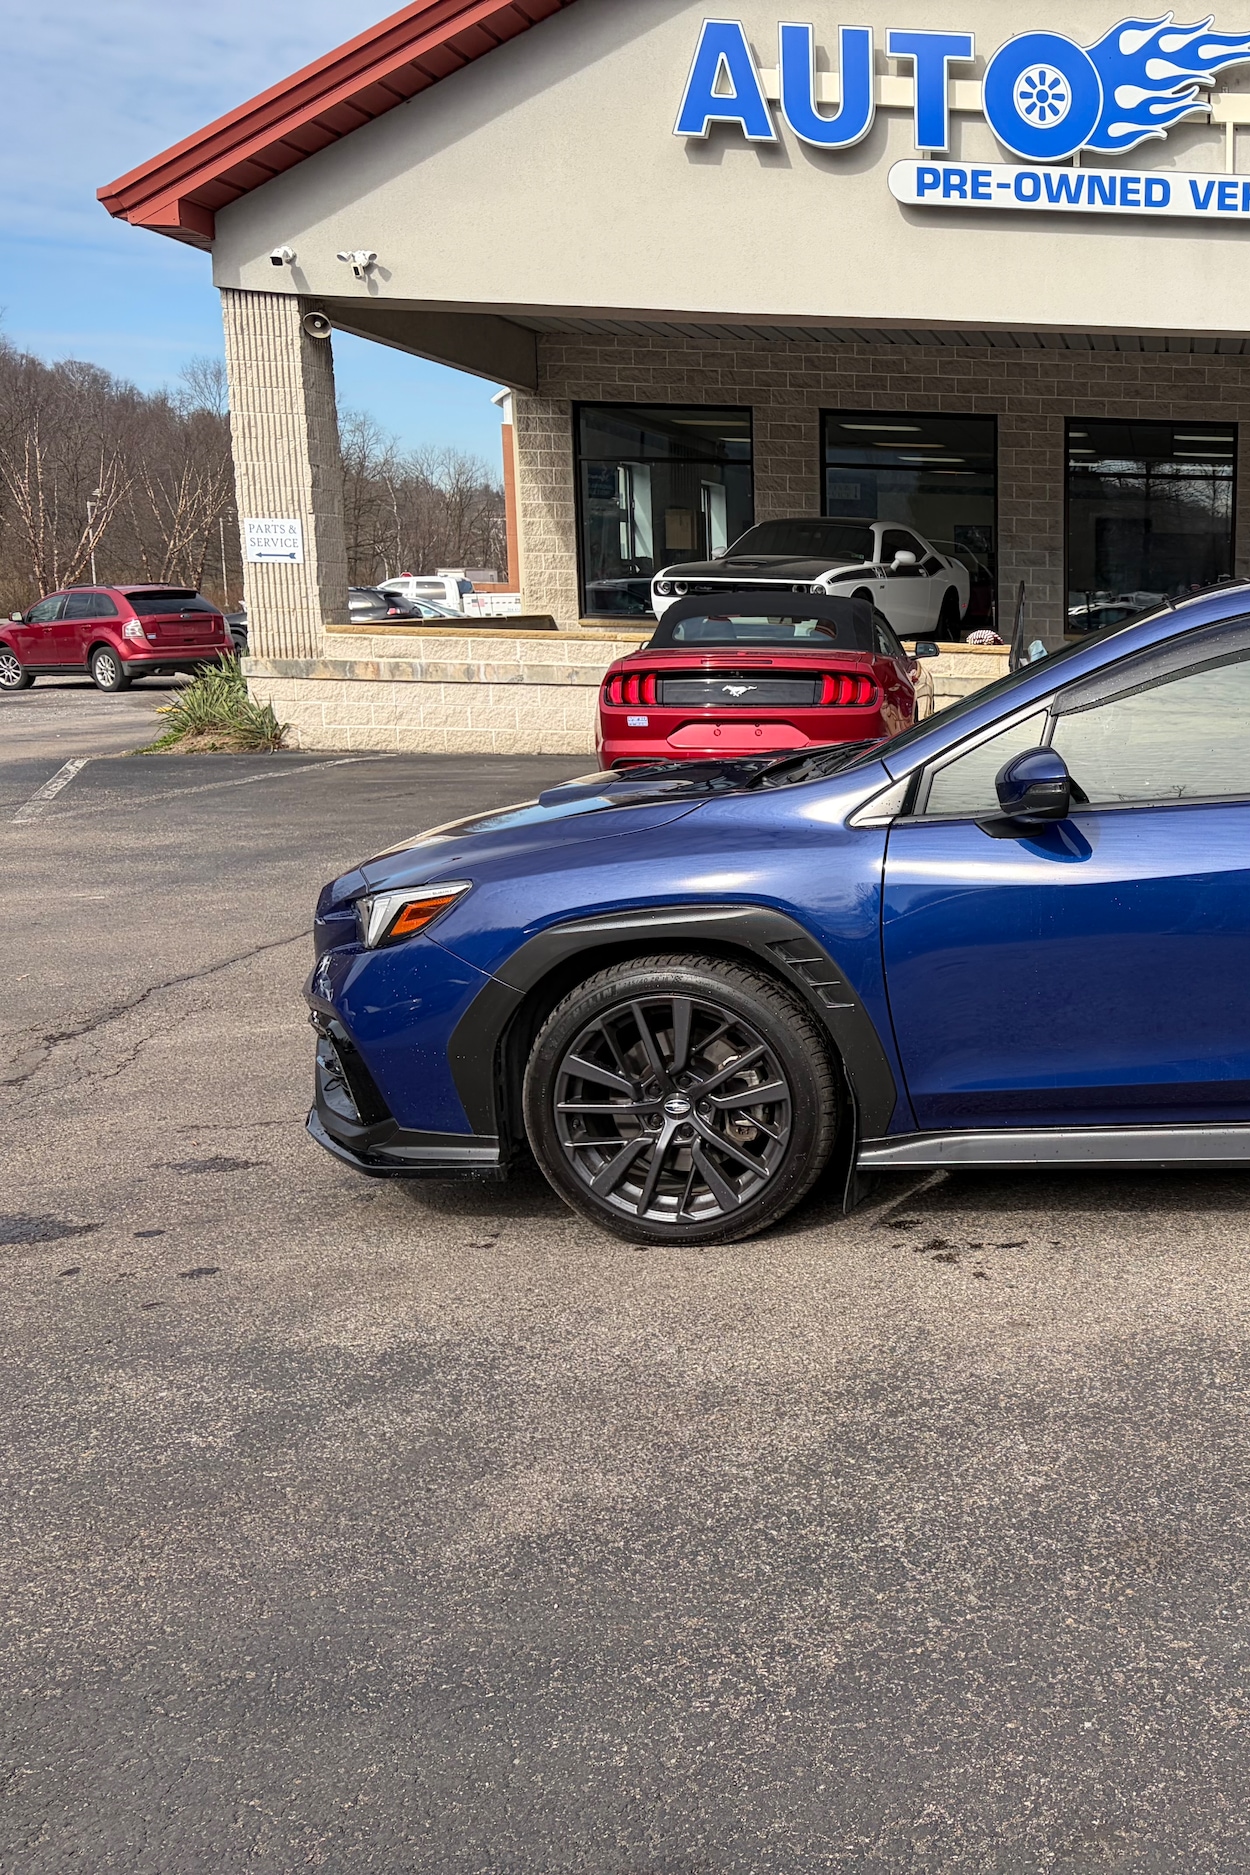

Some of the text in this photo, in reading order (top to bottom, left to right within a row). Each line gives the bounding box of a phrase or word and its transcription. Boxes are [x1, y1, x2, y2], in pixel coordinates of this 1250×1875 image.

[674, 19, 1103, 161] AUTO
[916, 167, 1171, 208] PRE-OWNED
[248, 524, 297, 534] PARTS &
[250, 537, 299, 548] SERVICE
